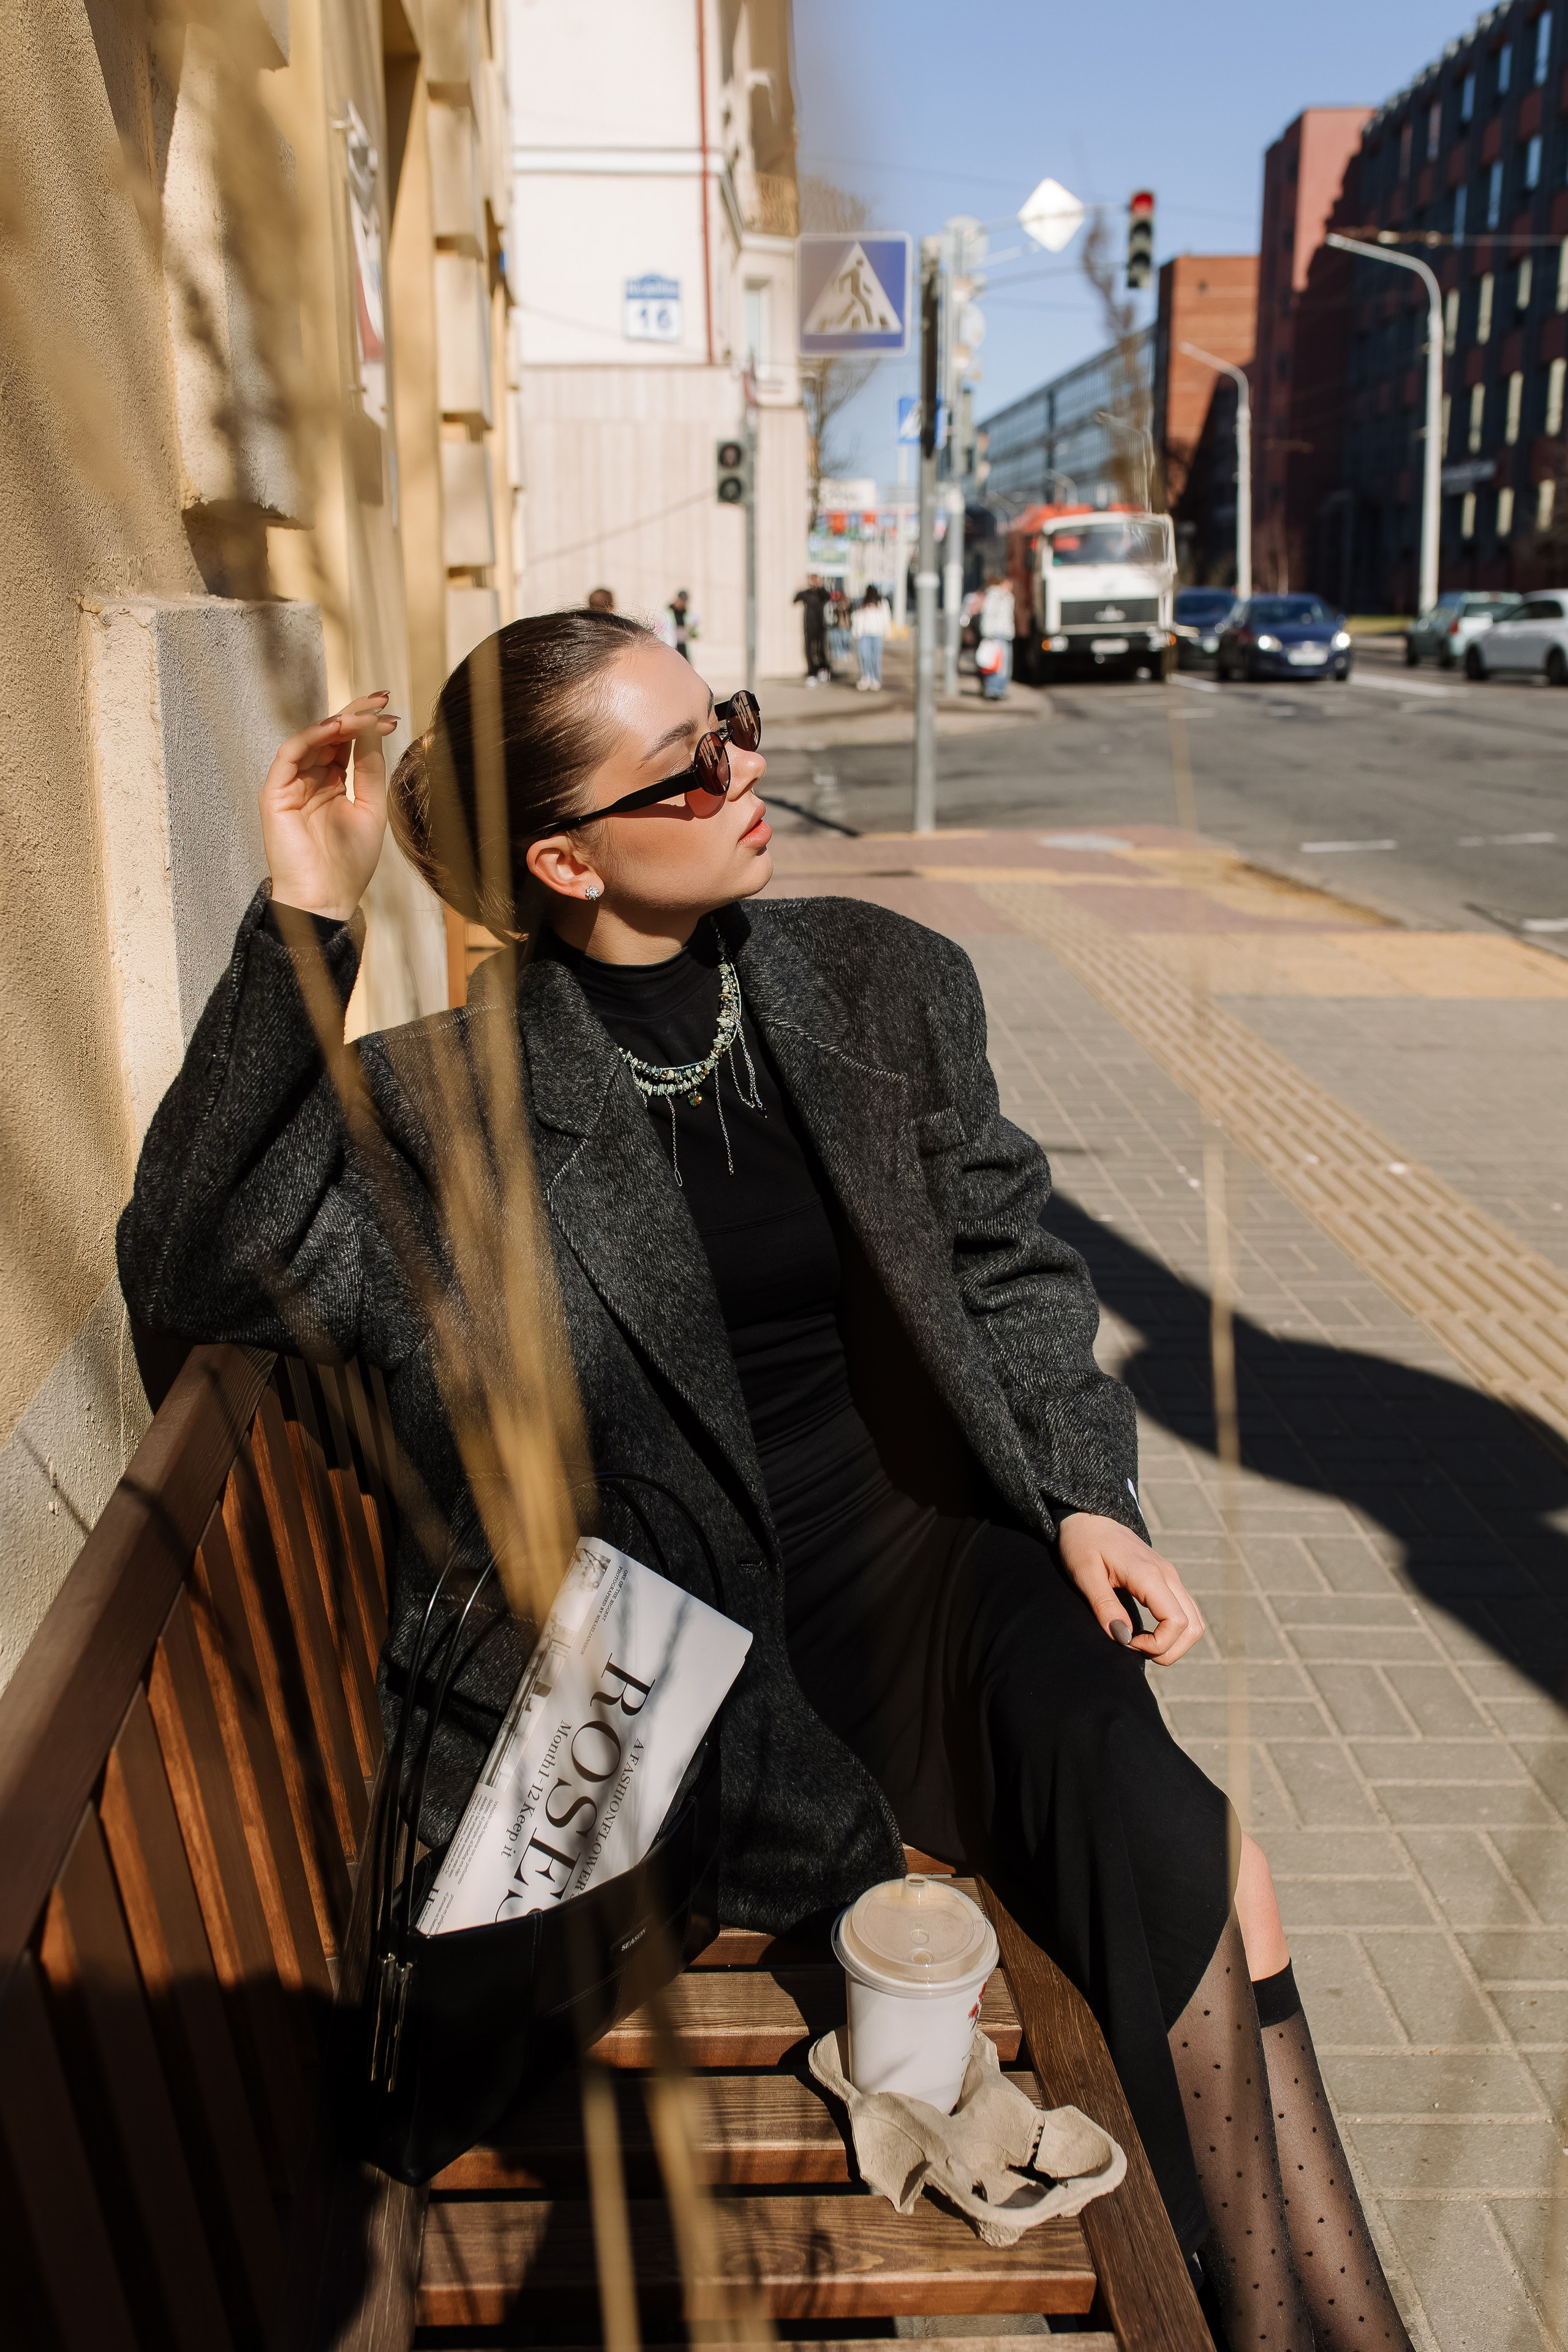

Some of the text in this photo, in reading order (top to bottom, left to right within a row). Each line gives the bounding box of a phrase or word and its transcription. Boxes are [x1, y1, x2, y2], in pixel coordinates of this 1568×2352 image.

[639, 307, 673, 330] 16
[602, 1566, 624, 1607] PHOTOGRAPHED
[612, 1589, 620, 1599] THE
[602, 1599, 614, 1622] BIGGEST
[633, 1738, 644, 1749] A
[507, 1797, 535, 1841] Keep
[501, 1844, 518, 1858] it
[621, 1926, 646, 1951] SEASON
